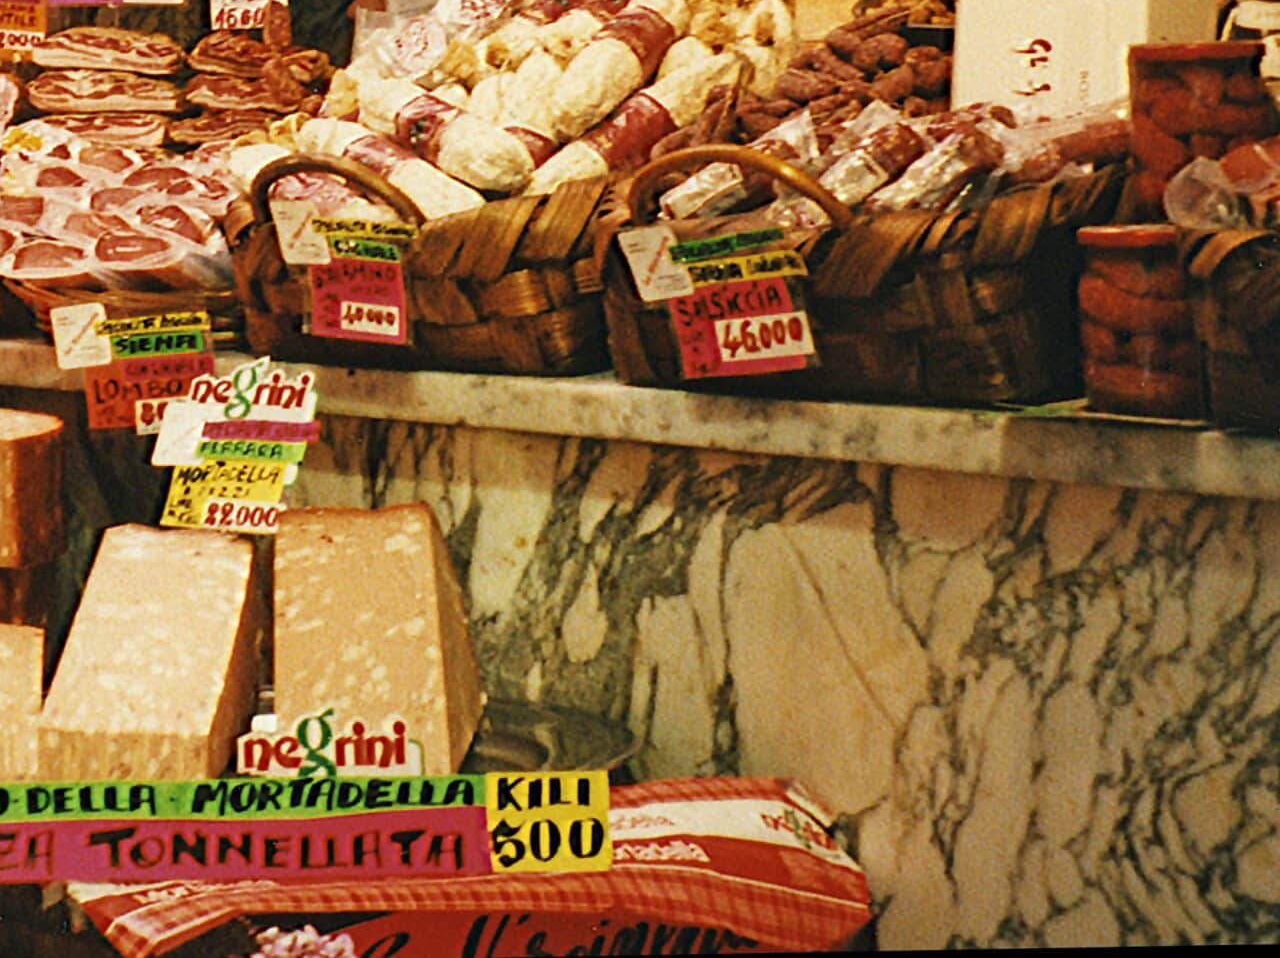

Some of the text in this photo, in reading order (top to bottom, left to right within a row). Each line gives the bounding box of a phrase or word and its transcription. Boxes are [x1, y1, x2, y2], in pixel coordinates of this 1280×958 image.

[723, 315, 804, 359] 46000
[192, 365, 309, 418] negrini
[203, 502, 281, 527] 22000
[243, 710, 407, 778] negrini
[23, 783, 157, 817] DELLA
[192, 774, 475, 815] MORTADELLA
[497, 778, 591, 811] KILI
[86, 825, 465, 870] TONNELLATA
[492, 817, 605, 866] 500
